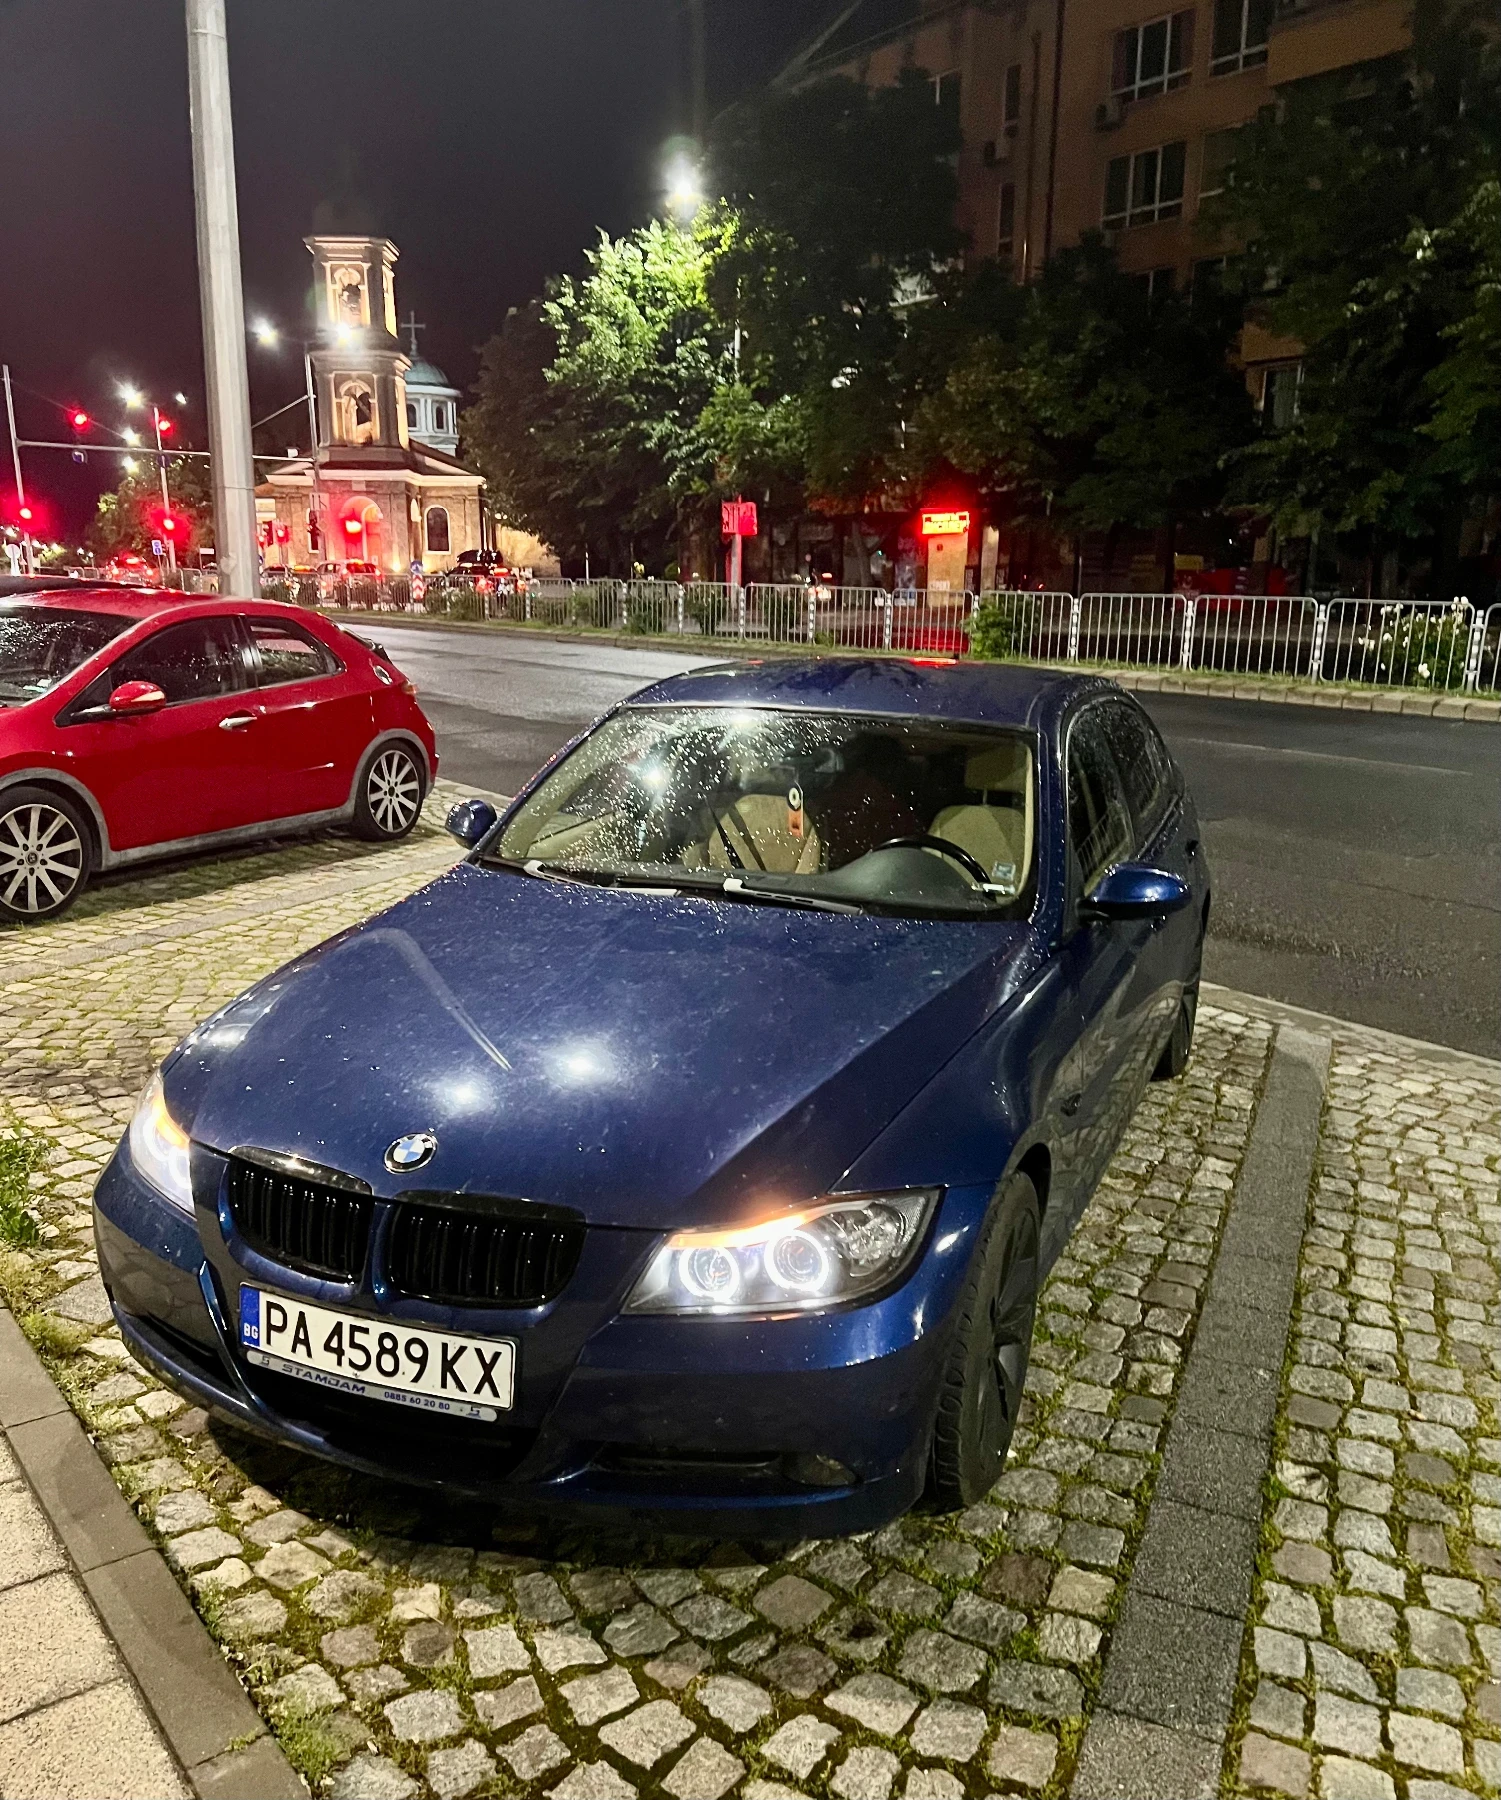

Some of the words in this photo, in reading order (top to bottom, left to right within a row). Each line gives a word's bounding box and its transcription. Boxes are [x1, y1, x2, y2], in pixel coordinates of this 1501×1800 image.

[243, 1322, 259, 1340] BG
[266, 1301, 313, 1359] PA
[323, 1321, 429, 1384] 4589
[440, 1342, 503, 1399] KX
[384, 1391, 407, 1402] 0885
[423, 1400, 436, 1408] 20
